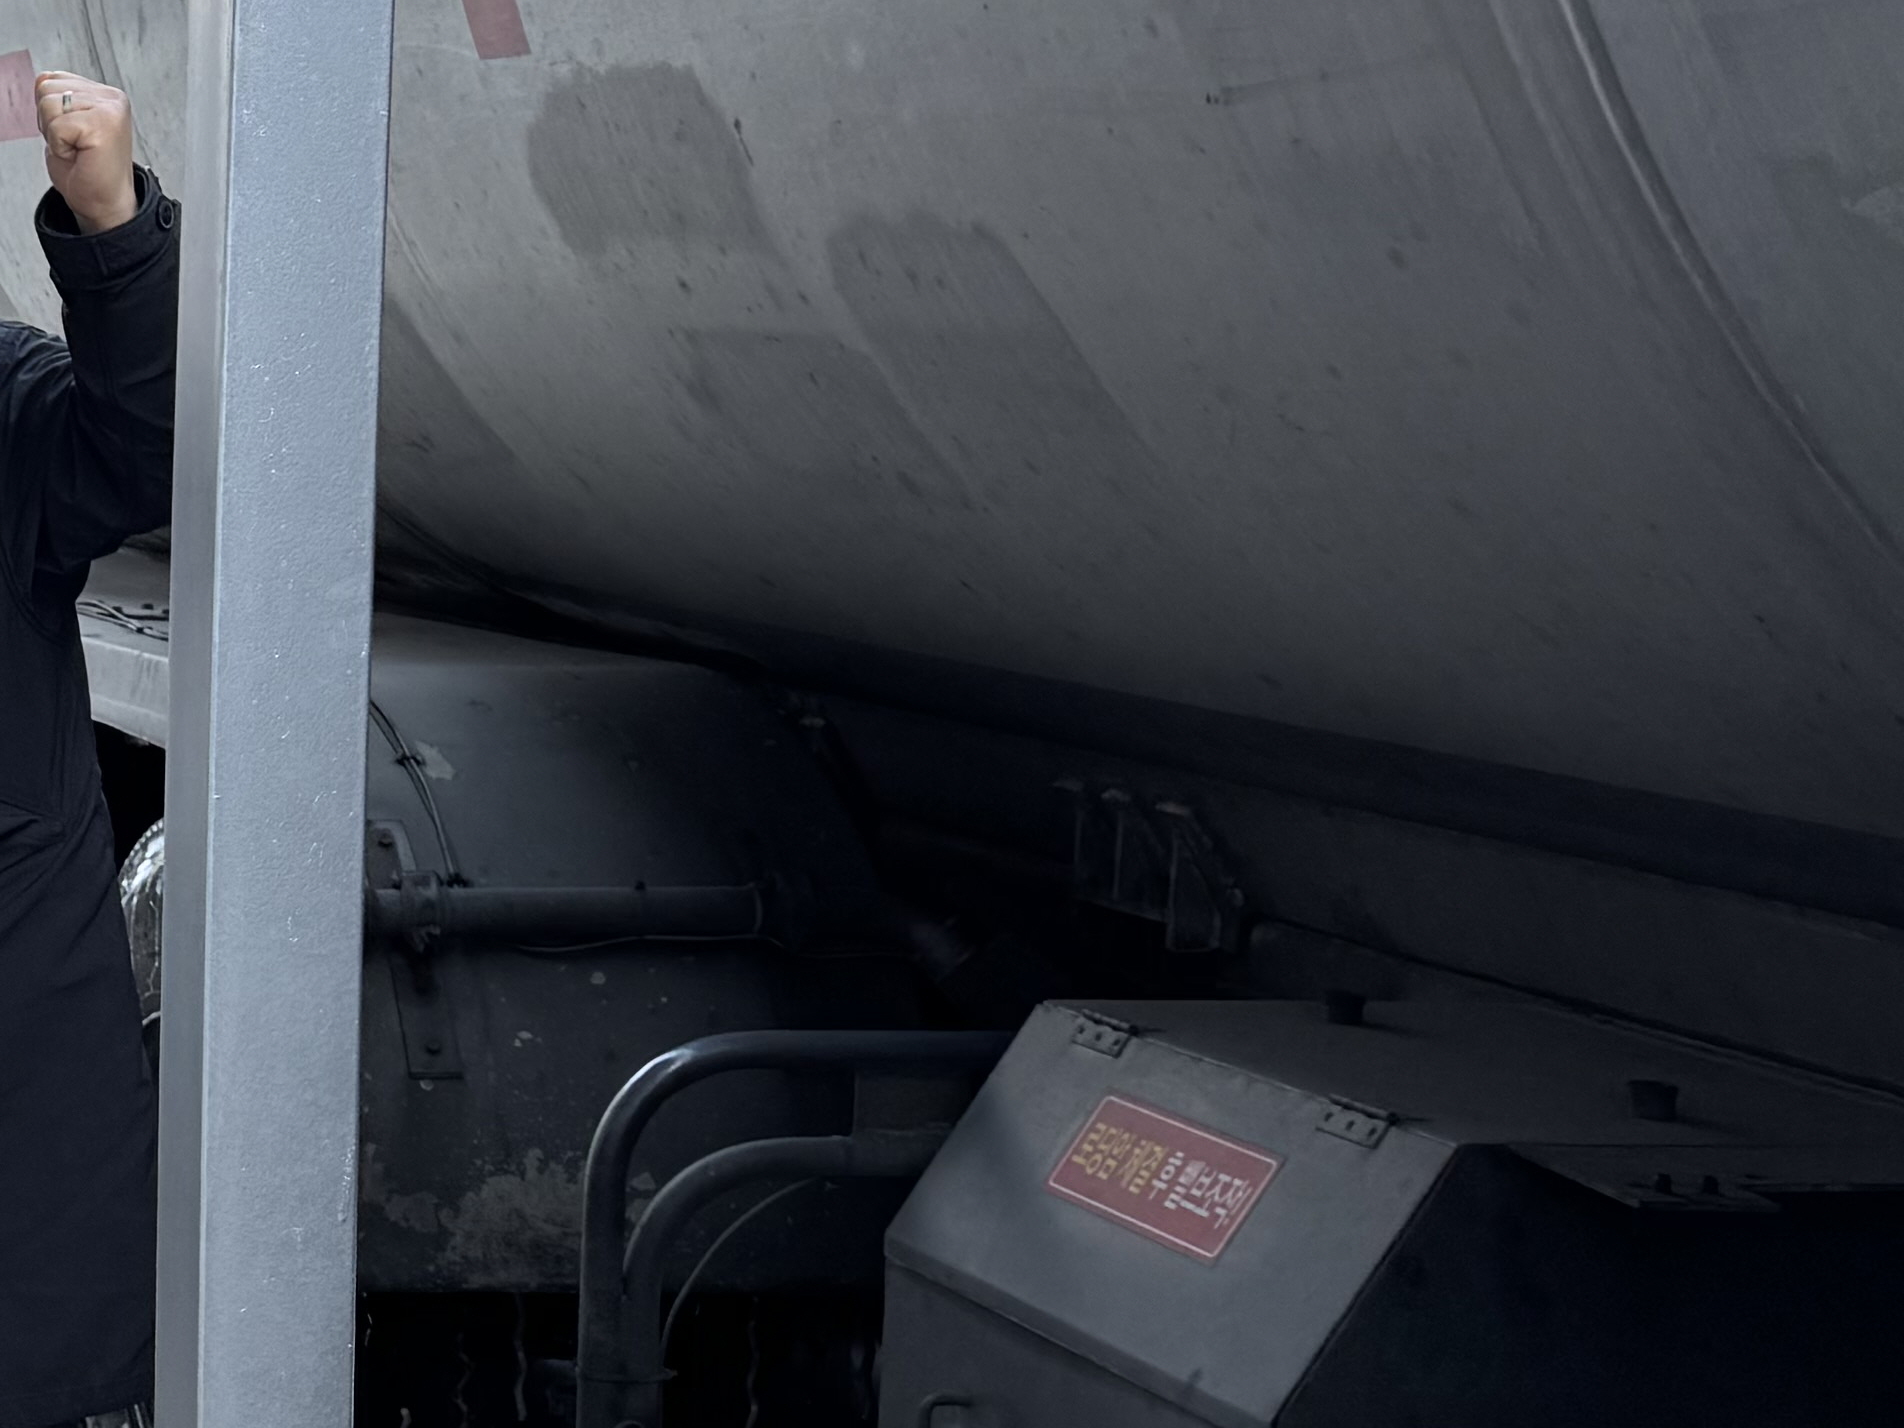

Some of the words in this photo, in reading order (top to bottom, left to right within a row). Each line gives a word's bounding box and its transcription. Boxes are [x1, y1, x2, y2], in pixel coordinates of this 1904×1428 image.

[1071, 1122, 1138, 1181] 로딩암
[1118, 1139, 1168, 1195] 체결
[1148, 1151, 1185, 1201] 후
